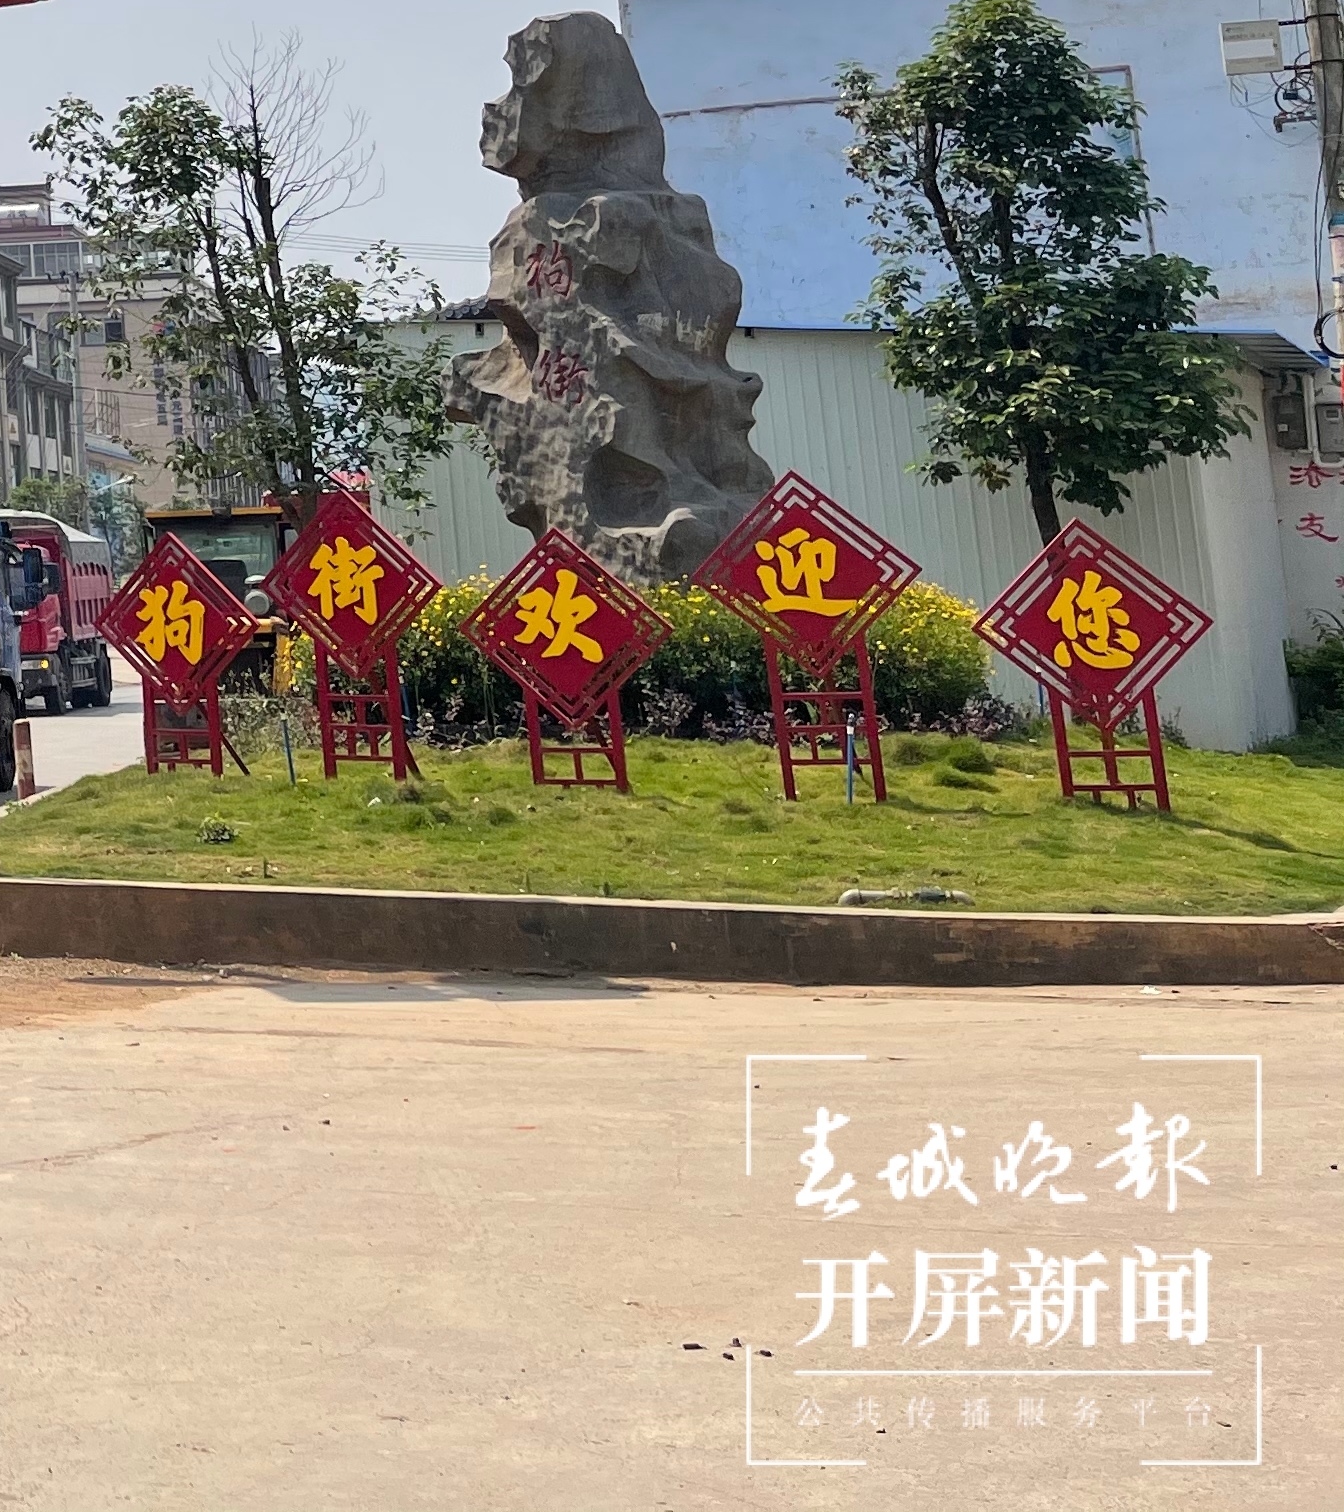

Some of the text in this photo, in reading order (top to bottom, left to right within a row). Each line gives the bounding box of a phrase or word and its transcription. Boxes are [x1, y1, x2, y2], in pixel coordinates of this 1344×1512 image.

[135, 527, 1141, 669] 狗 街 欢 迎 您
